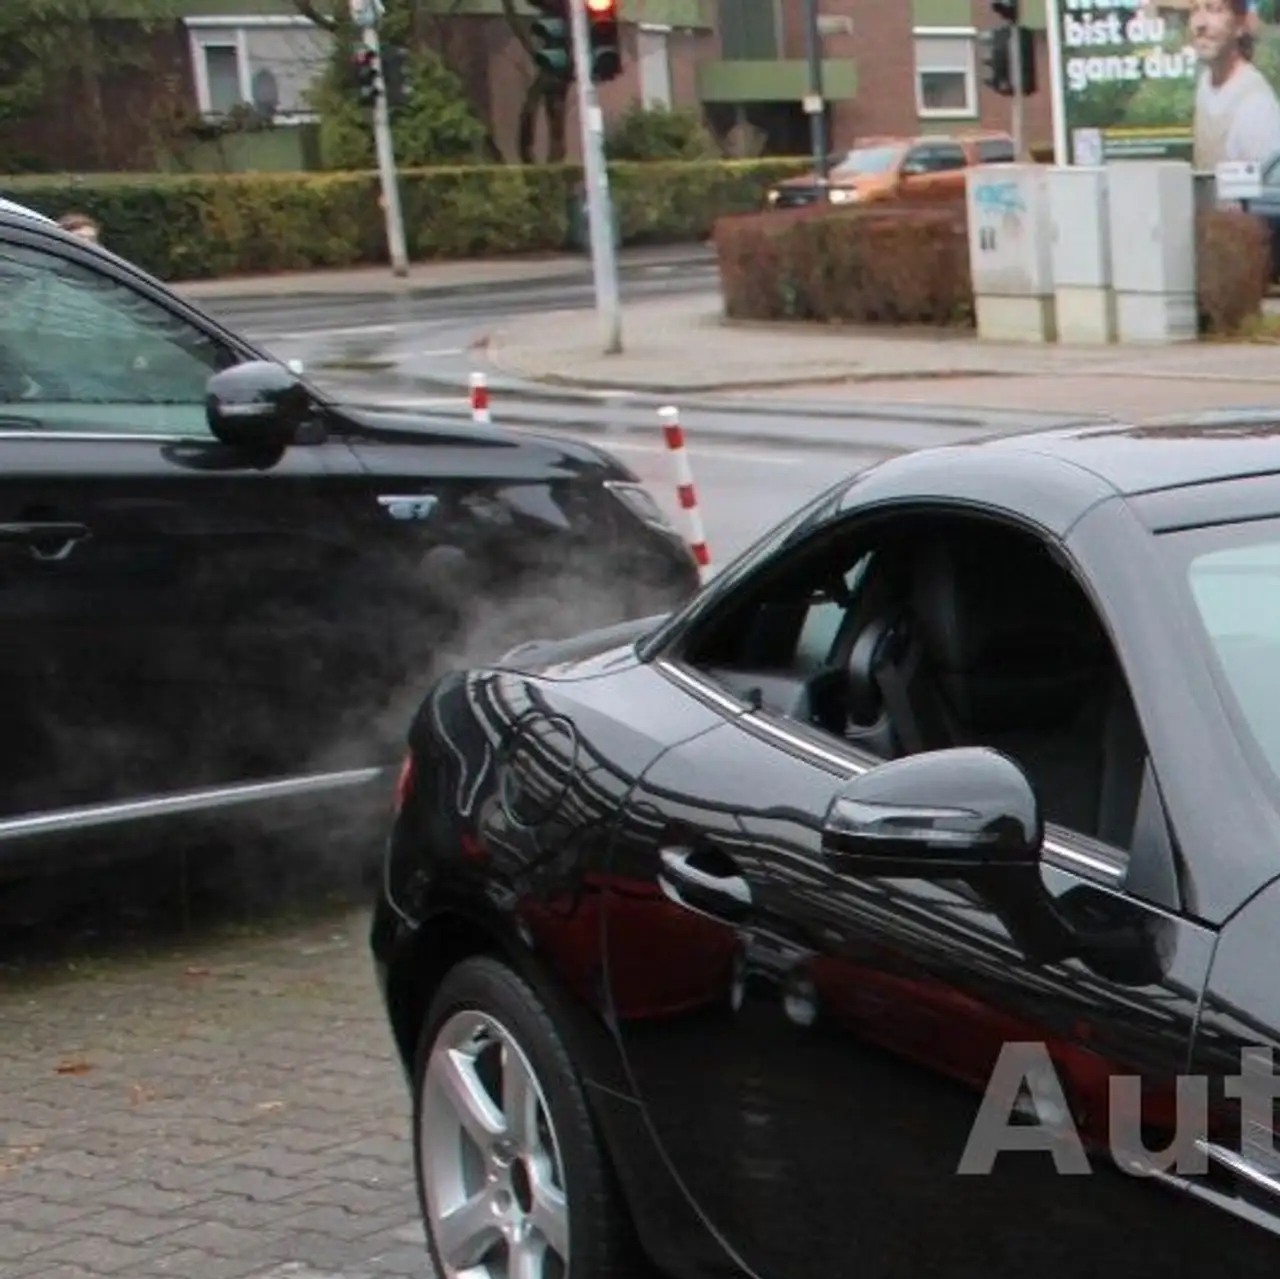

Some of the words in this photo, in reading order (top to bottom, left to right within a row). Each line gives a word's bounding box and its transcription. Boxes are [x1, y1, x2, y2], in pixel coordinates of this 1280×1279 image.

[1063, 13, 1122, 46] bist
[1126, 9, 1166, 43] du
[1066, 55, 1141, 91] ganz
[1144, 46, 1196, 78] du?
